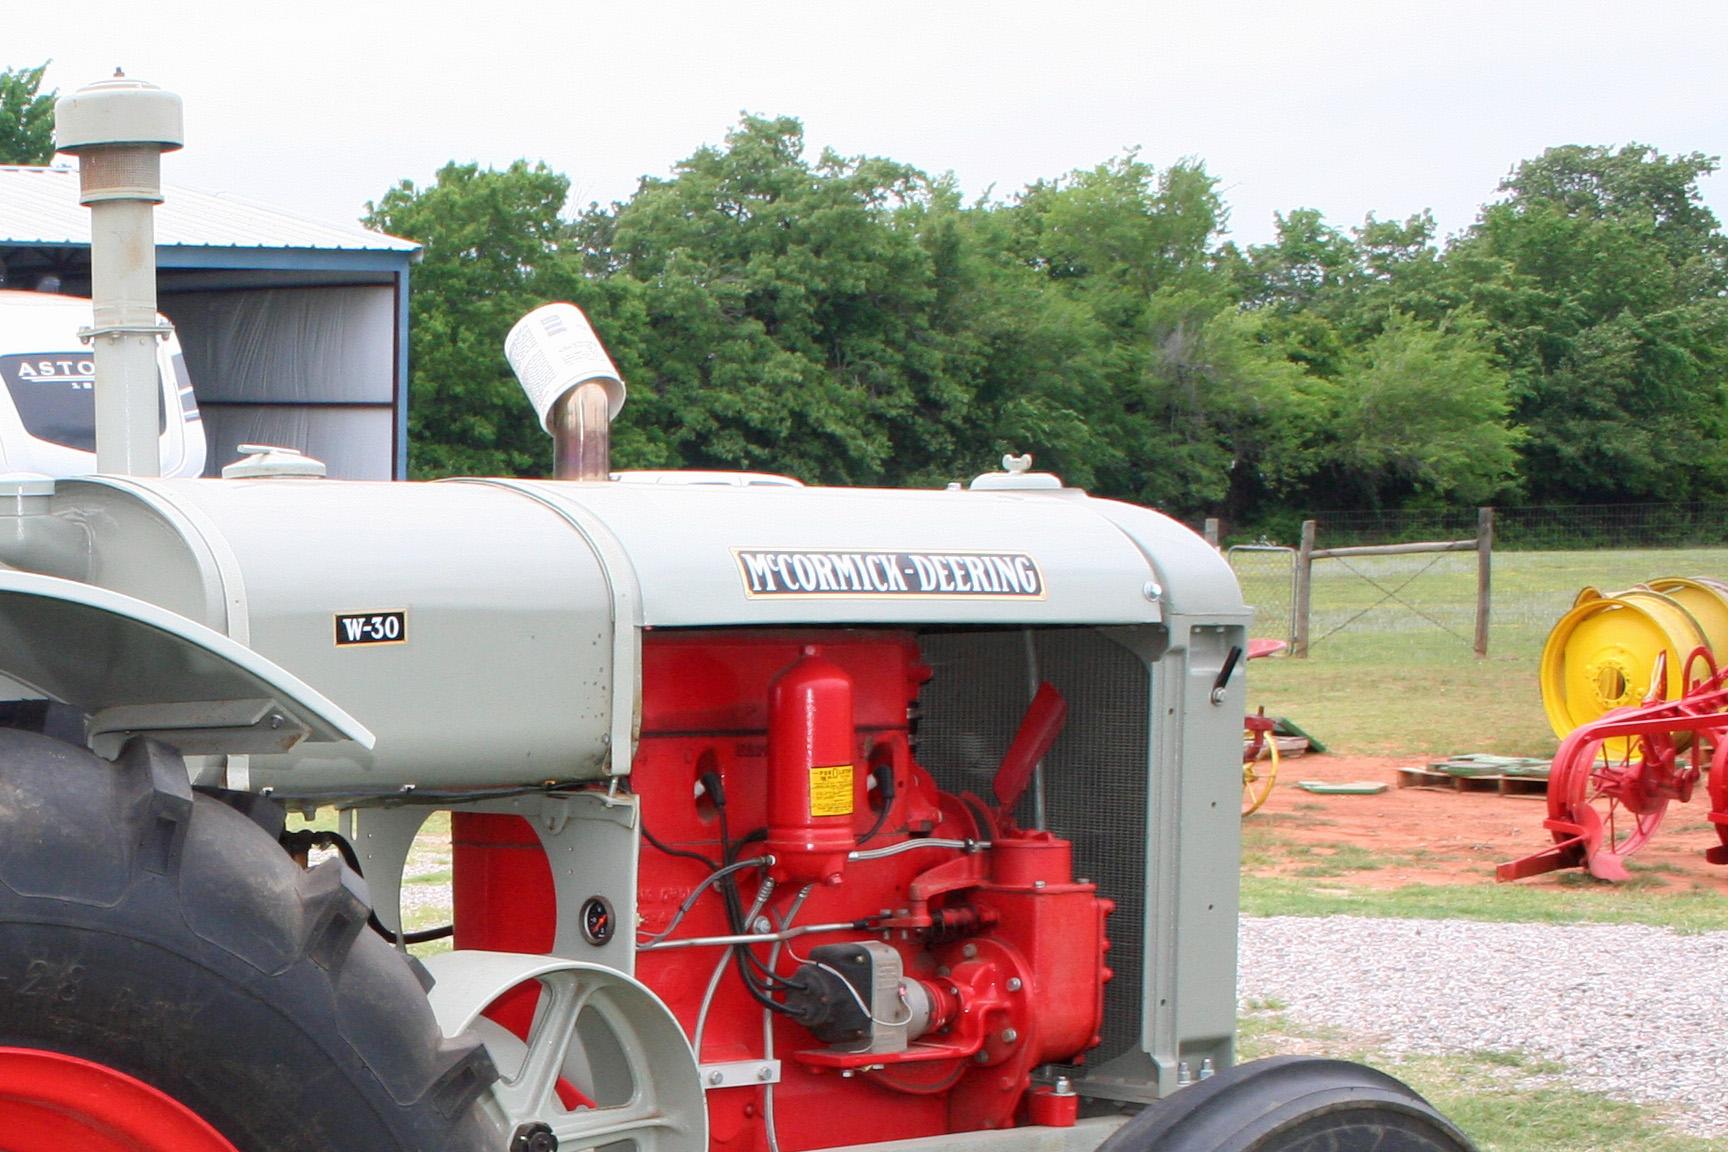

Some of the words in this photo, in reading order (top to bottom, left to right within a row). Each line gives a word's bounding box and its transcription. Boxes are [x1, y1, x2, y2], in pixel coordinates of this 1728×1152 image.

[18, 361, 95, 377] ASTO
[740, 552, 1038, 594] McCORMICK-DEERING
[342, 615, 400, 641] W-30
